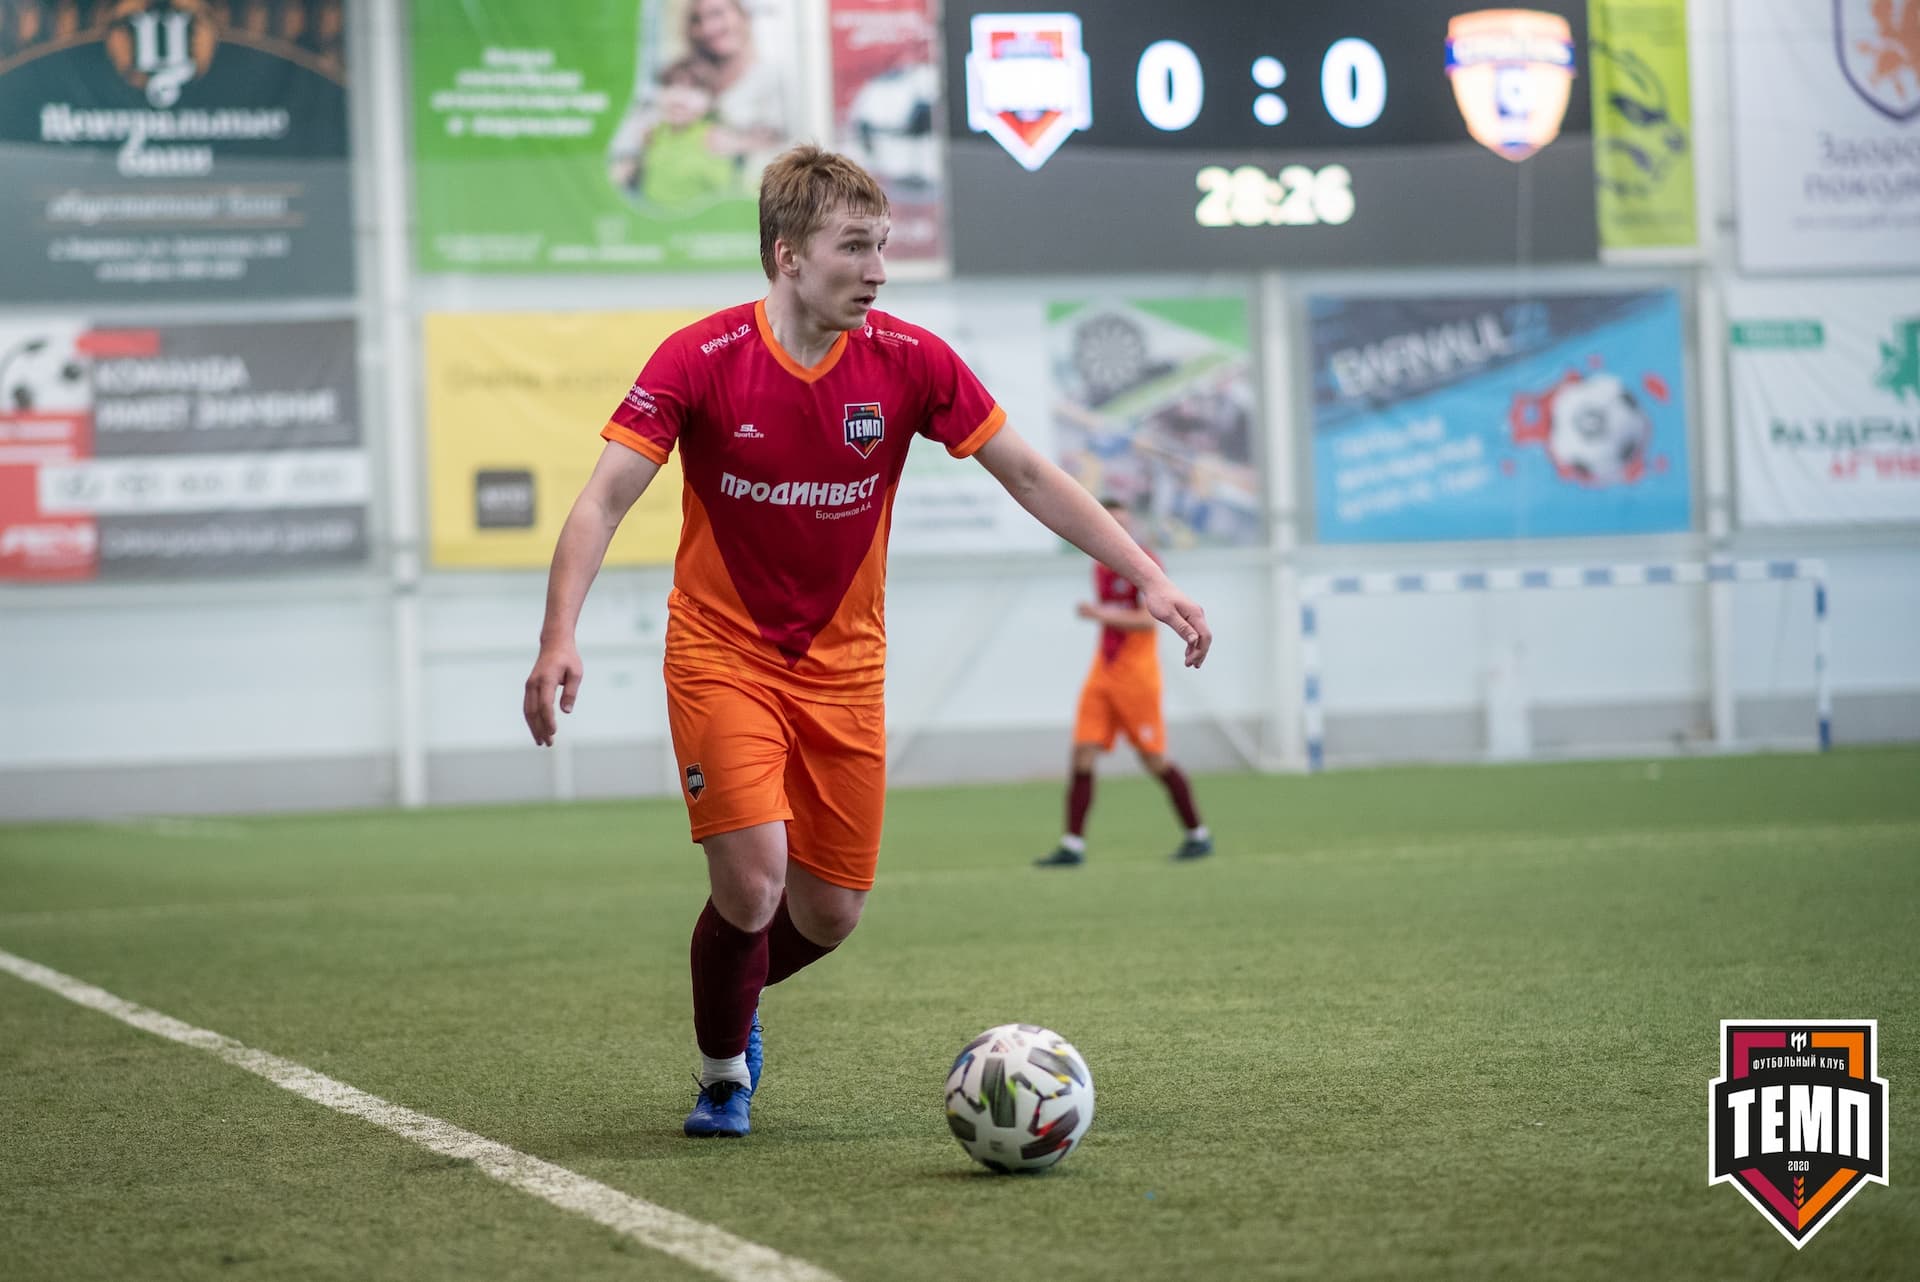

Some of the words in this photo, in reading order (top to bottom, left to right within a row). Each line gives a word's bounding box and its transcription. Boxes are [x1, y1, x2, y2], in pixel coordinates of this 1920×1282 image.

[1137, 40, 1204, 131] 0
[1321, 38, 1387, 128] 0
[1196, 164, 1355, 227] 28:26
[848, 418, 881, 440] ТЕМП
[720, 472, 880, 507] ПРОДИНВЕСТ
